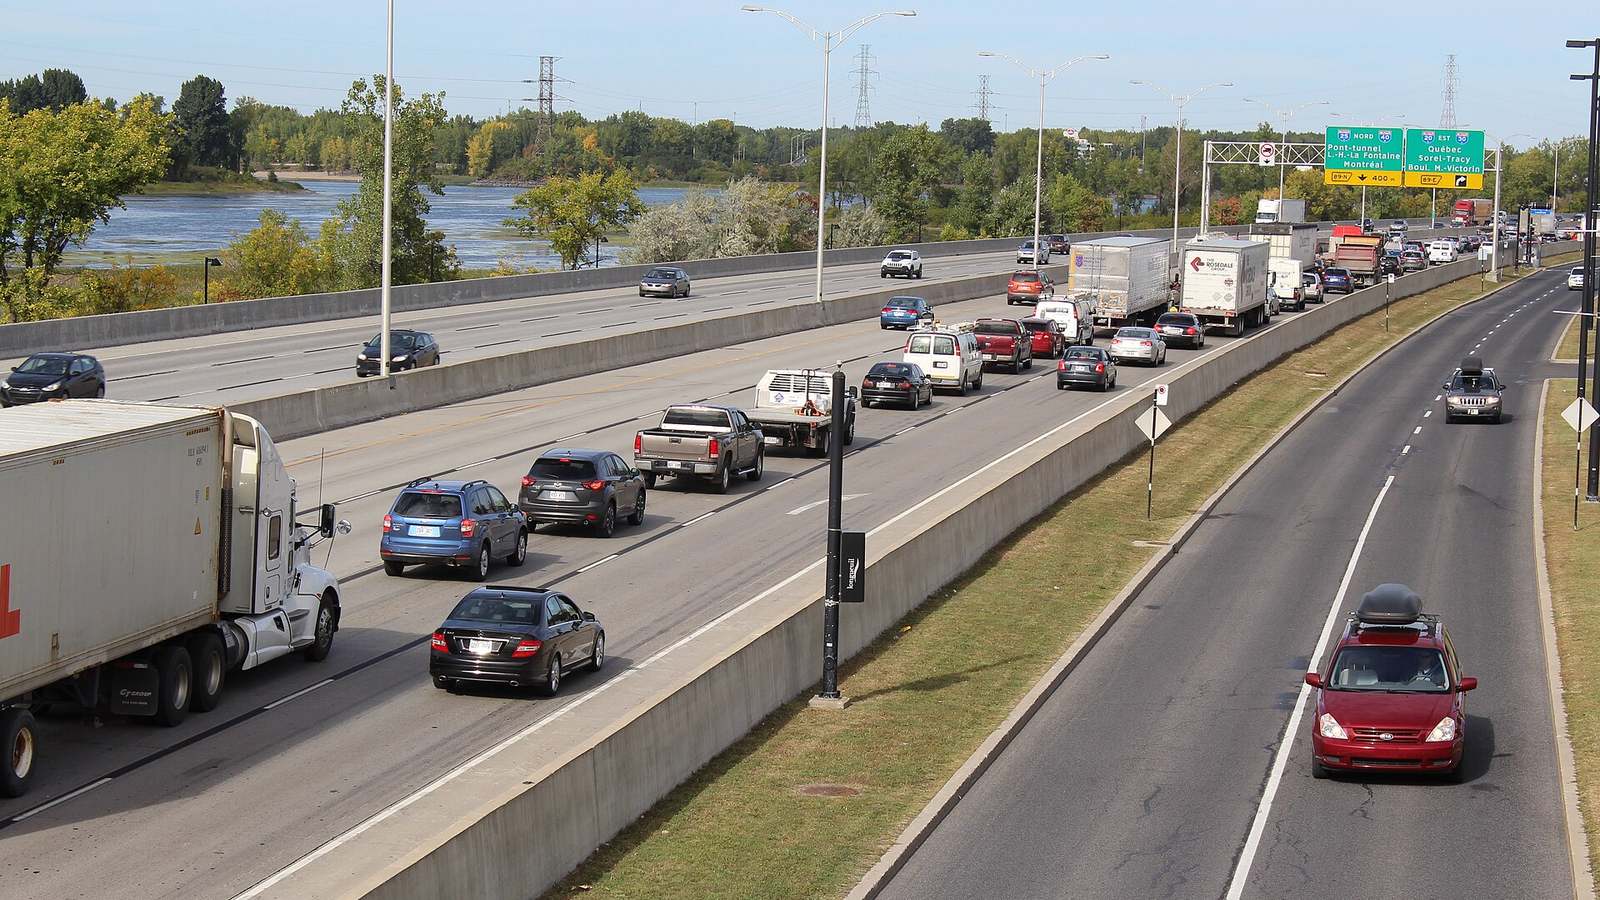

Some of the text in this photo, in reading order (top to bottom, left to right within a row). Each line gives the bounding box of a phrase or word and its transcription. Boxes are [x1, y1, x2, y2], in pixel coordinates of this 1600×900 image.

[1327, 143, 1381, 152] Pont-tunnel
[1428, 145, 1462, 153] Québec
[1363, 152, 1401, 160] Fontaine
[1418, 154, 1471, 164] Sorel-Tracy
[1434, 165, 1480, 173] M.-Victorin
